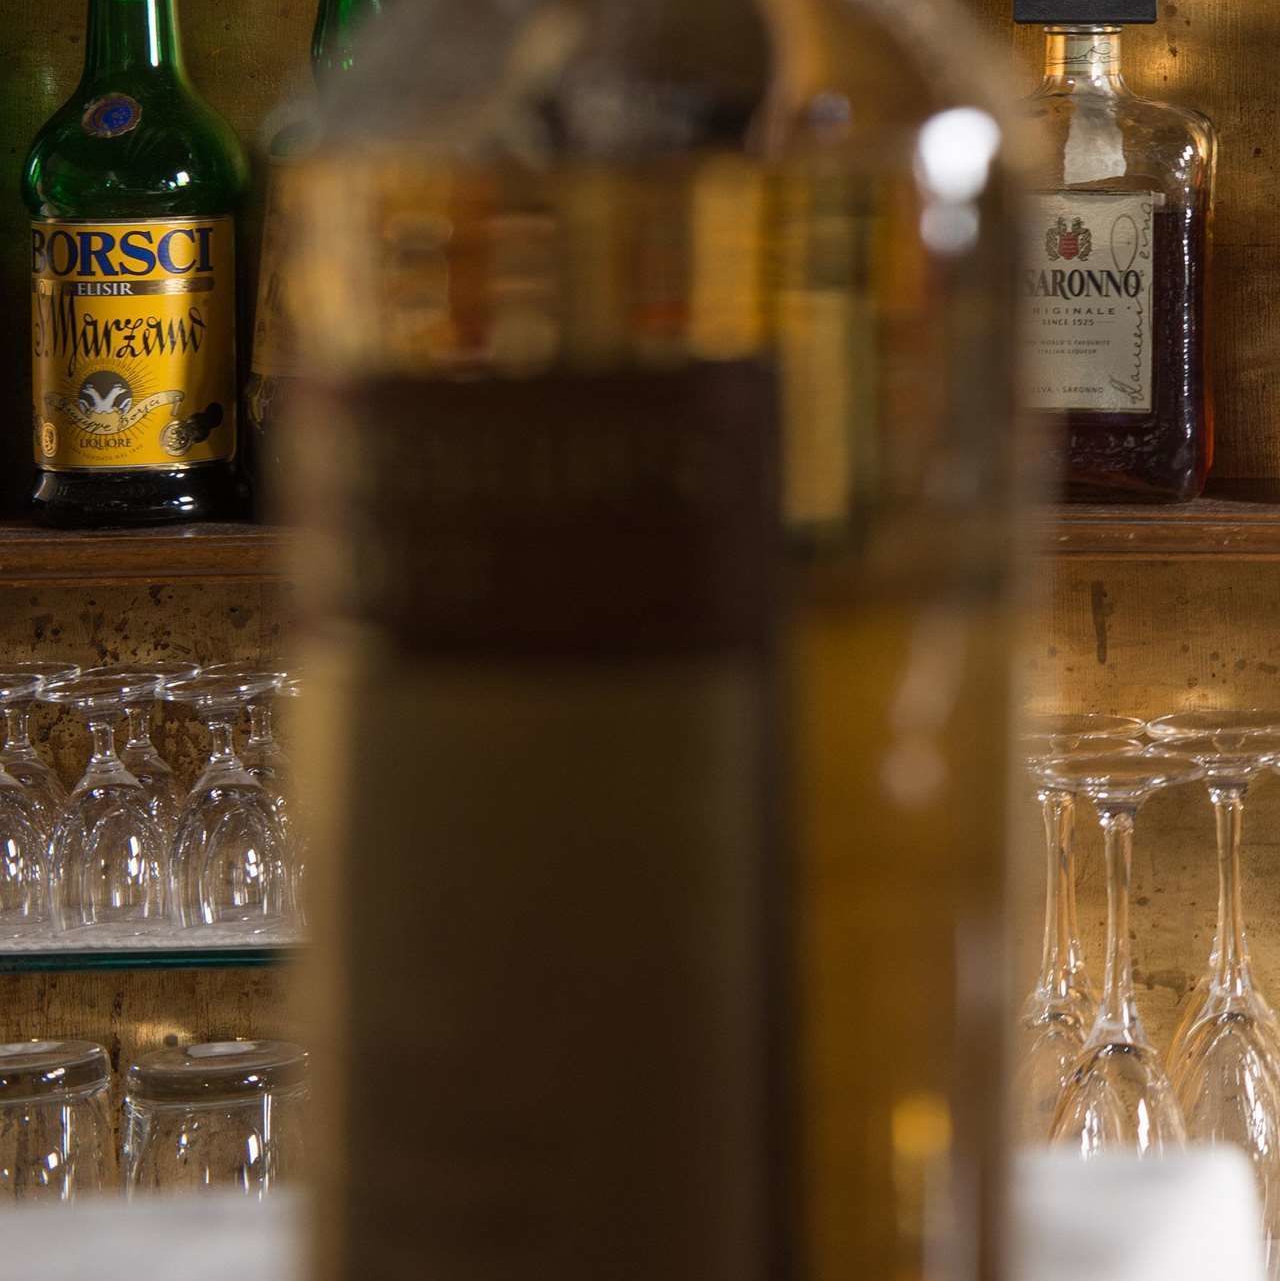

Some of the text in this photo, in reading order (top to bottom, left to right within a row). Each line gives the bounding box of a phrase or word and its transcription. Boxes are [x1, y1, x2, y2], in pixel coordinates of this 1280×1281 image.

[32, 227, 214, 277] BORSCI
[77, 282, 135, 296] ELISIR
[1022, 269, 1141, 300] SARONNO
[79, 438, 133, 449] LIQUORE
